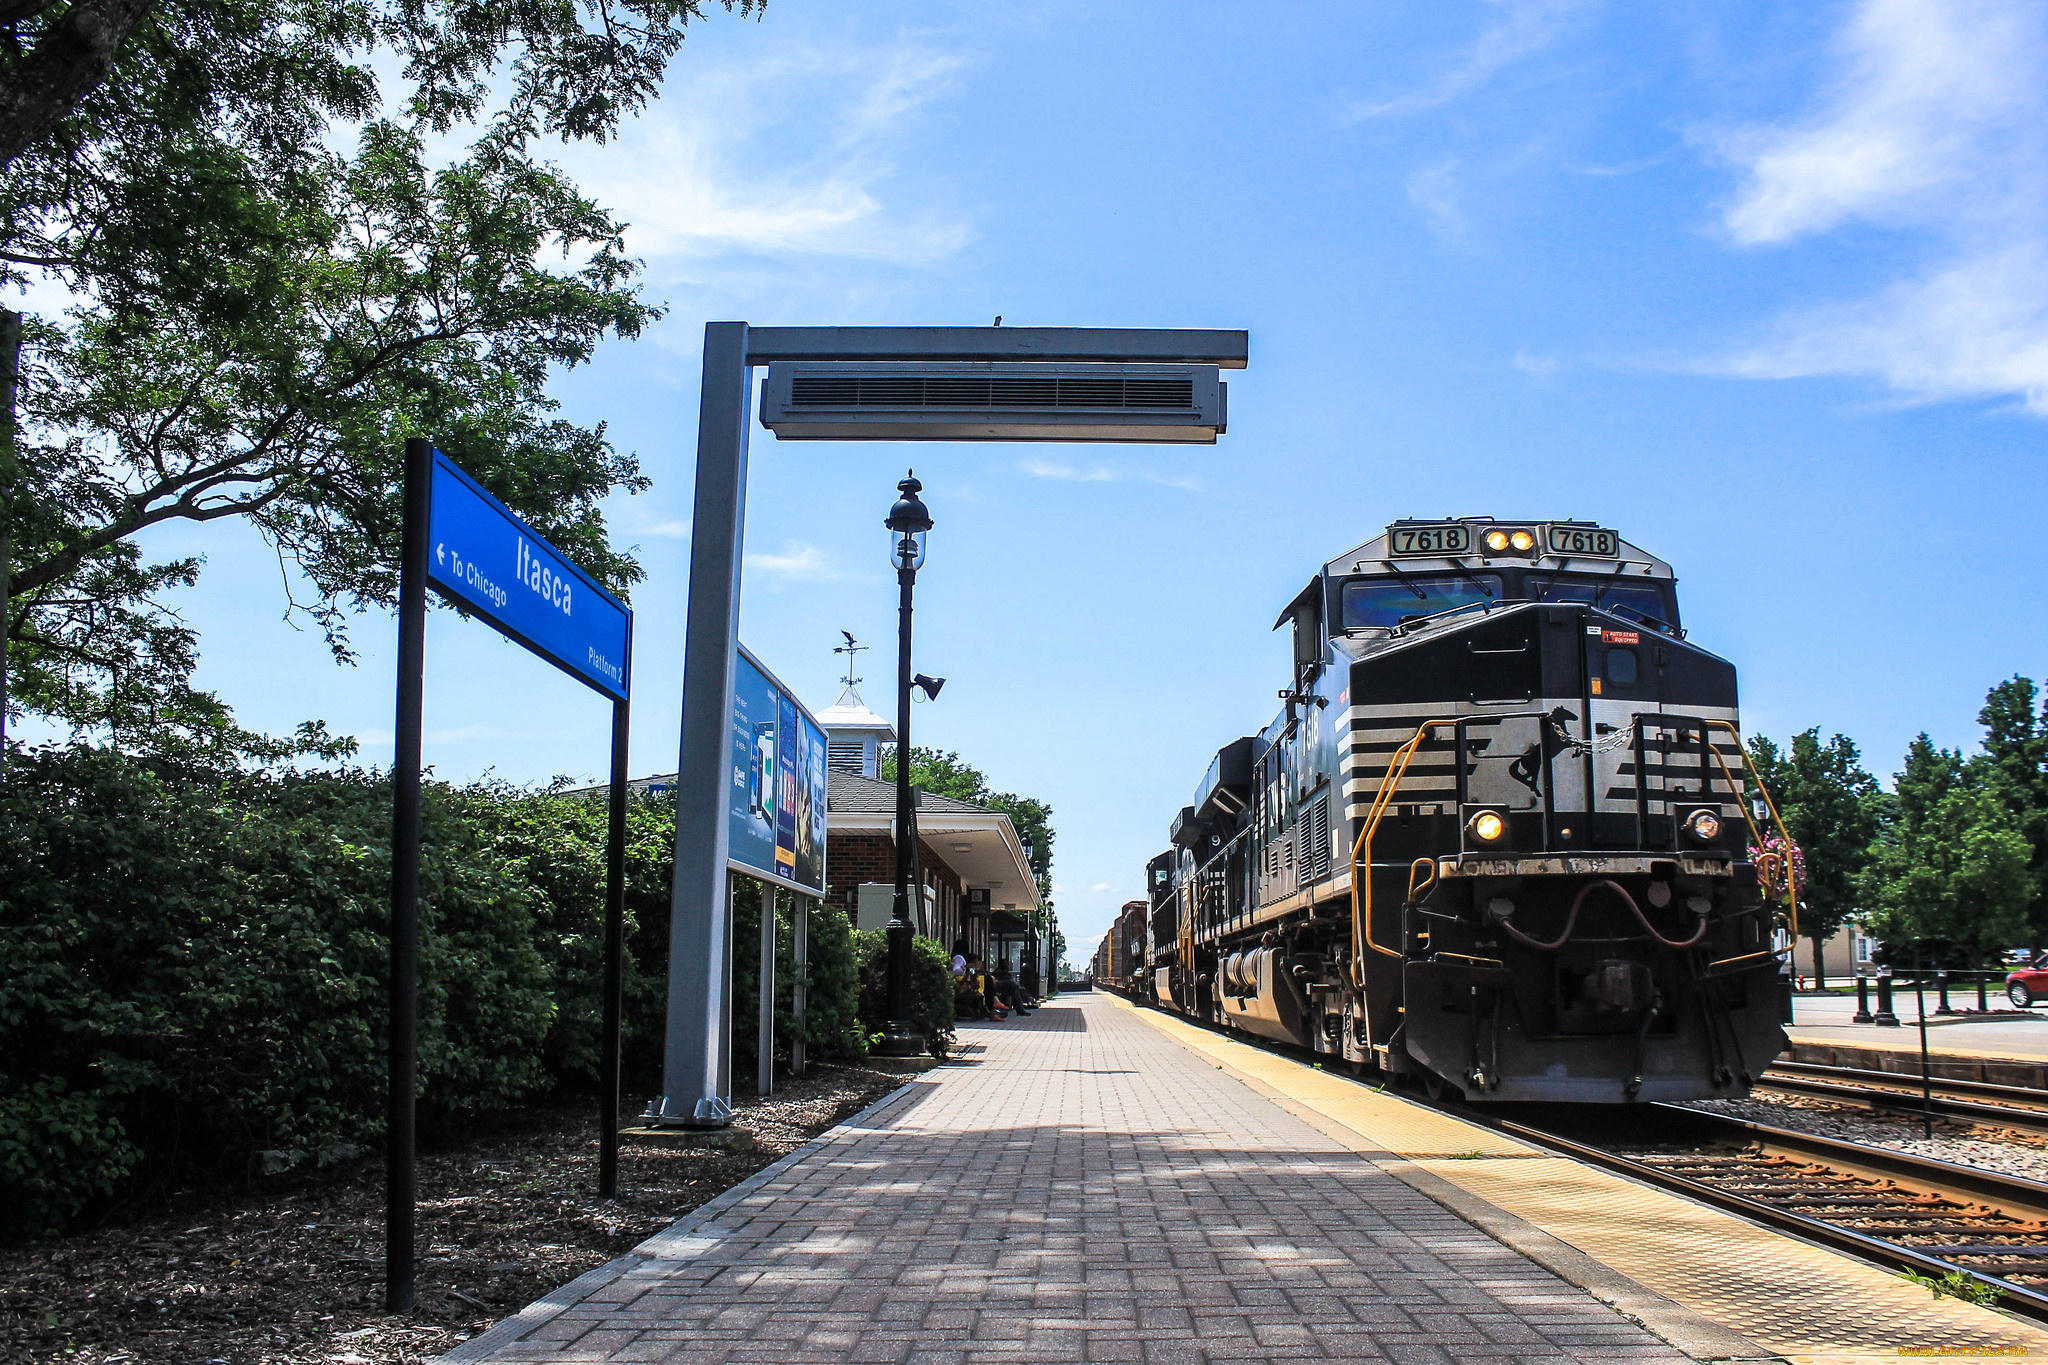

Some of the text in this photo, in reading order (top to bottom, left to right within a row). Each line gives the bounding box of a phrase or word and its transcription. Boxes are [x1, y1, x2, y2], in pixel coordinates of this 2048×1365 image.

[1402, 530, 1461, 550] 7618
[1558, 530, 1610, 552] 7618
[451, 550, 507, 608] To Chicago
[516, 536, 572, 616] Itasca
[588, 646, 622, 683] Platform 2
[1302, 708, 1319, 757] 7618
